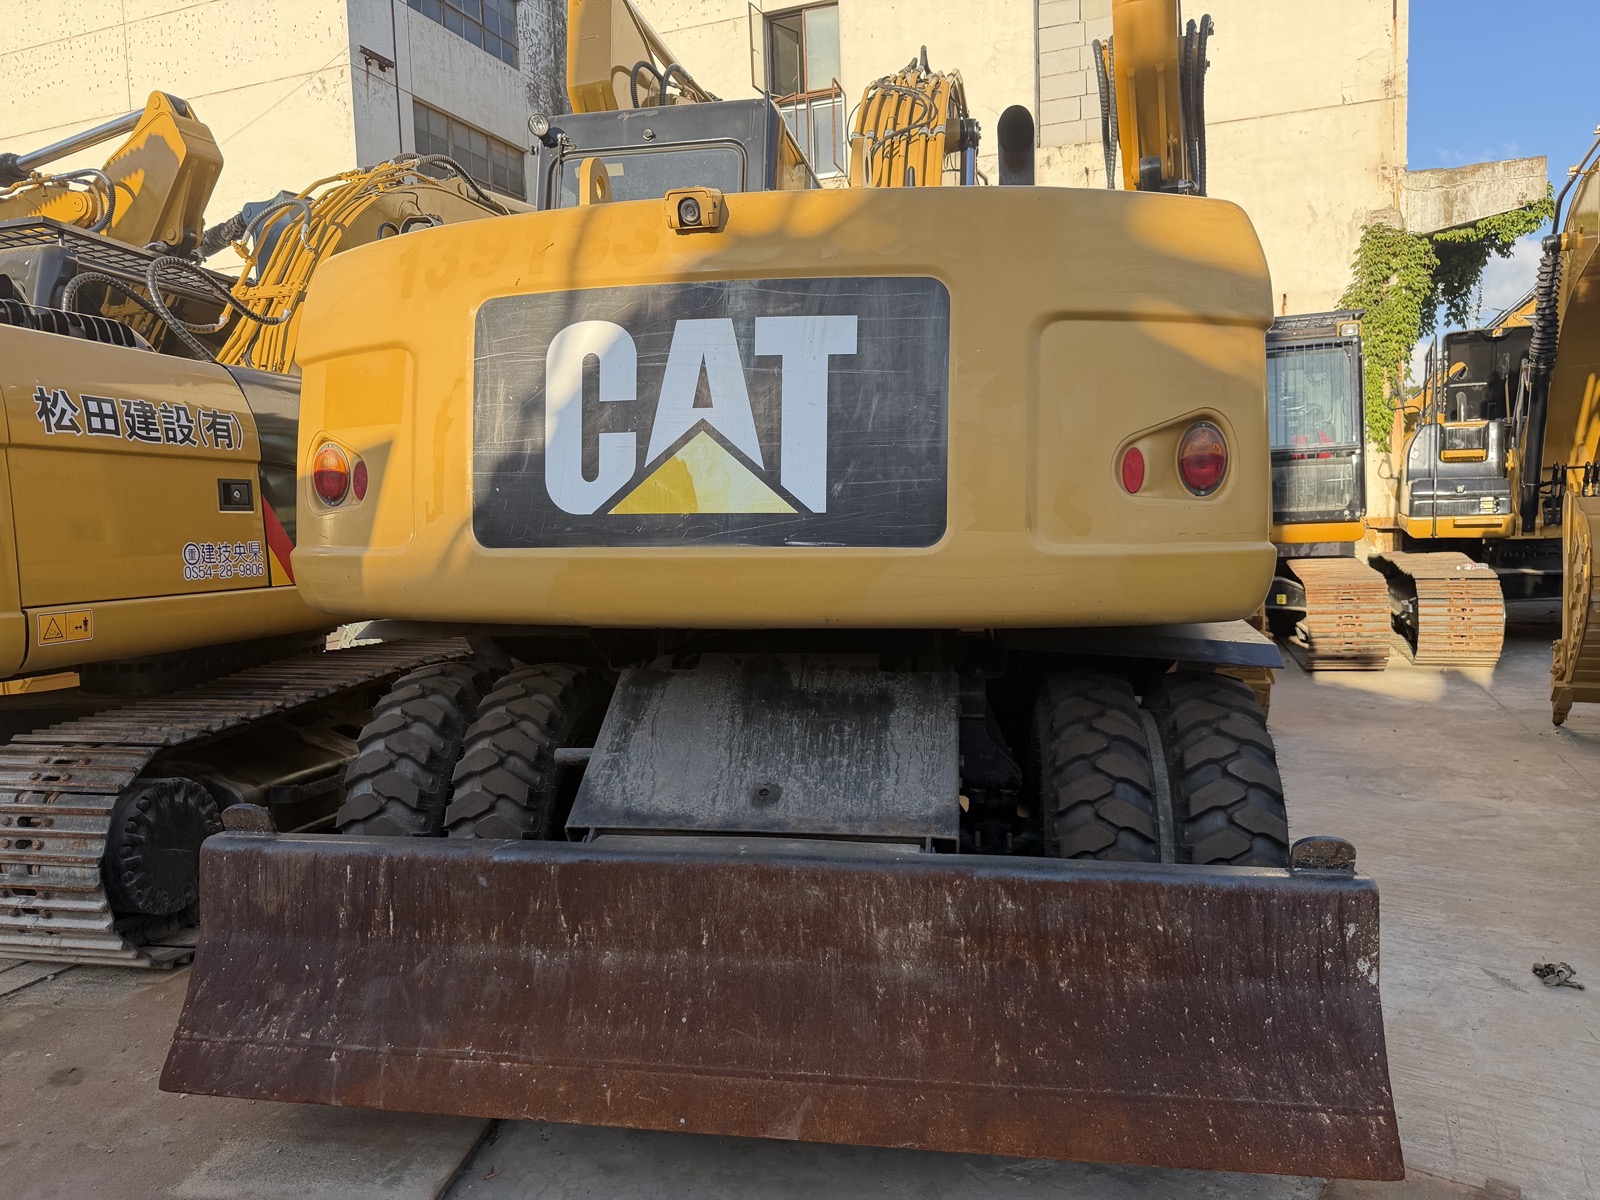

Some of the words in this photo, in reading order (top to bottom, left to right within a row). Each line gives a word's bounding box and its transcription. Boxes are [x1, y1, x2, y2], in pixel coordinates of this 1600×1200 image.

[34, 386, 243, 450] 松田建設(有)
[545, 315, 858, 515] CAT
